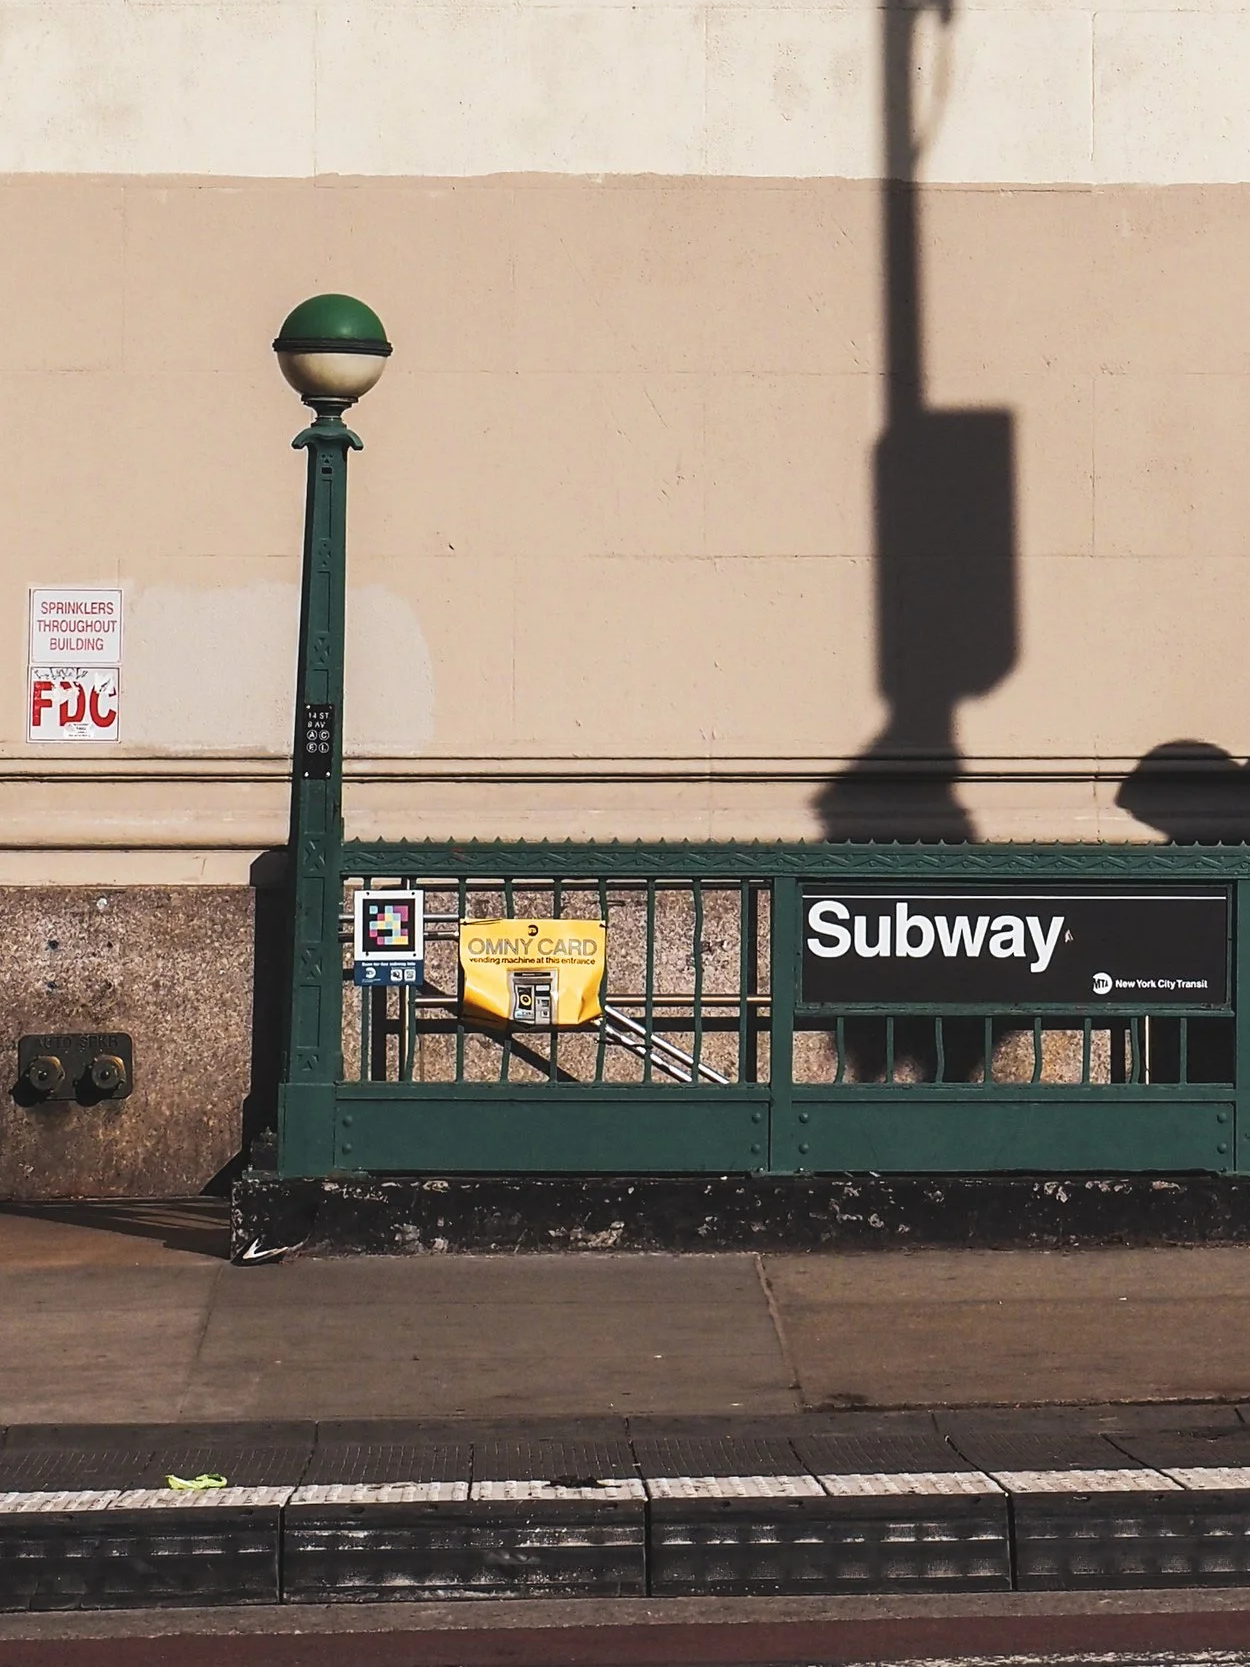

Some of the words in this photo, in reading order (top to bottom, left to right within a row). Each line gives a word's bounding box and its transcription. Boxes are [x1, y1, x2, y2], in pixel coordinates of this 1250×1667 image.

[41, 602, 114, 615] SPRINKLERS
[37, 620, 117, 633] THROUGHOUT
[50, 638, 104, 651] BUILDING
[32, 681, 117, 728] FDC
[319, 712, 329, 720] ST
[806, 900, 1065, 973] Subway
[468, 937, 534, 955] OMNY
[538, 938, 598, 956] CARD
[469, 957, 500, 965] vending
[1115, 979, 1135, 989] New
[1136, 979, 1156, 989] York
[1158, 979, 1176, 990] City
[1176, 979, 1208, 989] Transit
[37, 1035, 72, 1049] AUTO
